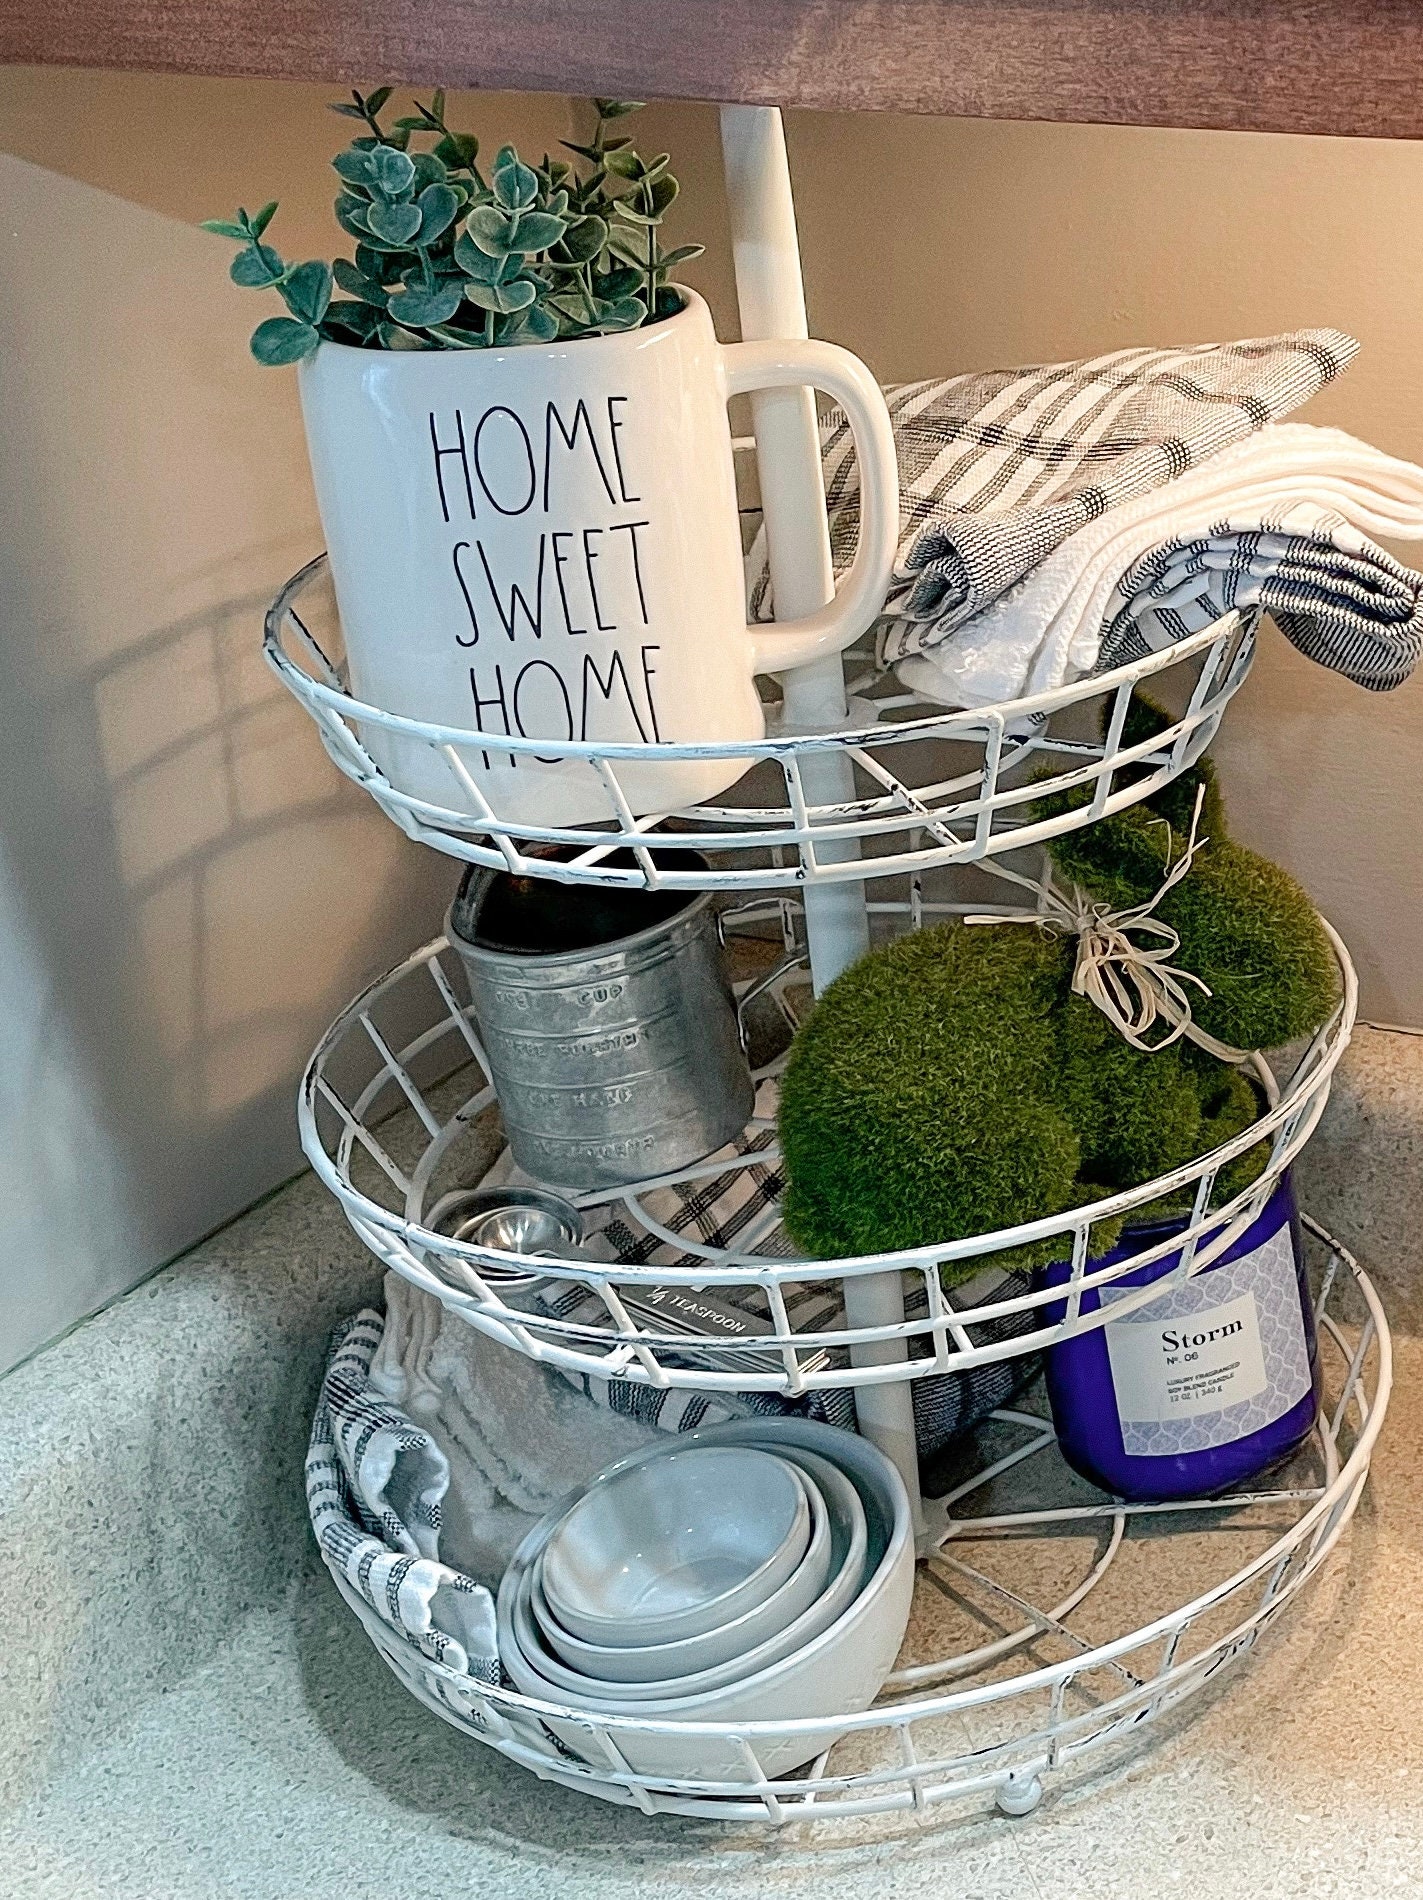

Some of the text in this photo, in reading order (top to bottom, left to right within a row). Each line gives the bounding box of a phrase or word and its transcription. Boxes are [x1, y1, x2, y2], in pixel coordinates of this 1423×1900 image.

[429, 396, 641, 522] HOME
[453, 521, 649, 647] SWEET
[469, 645, 675, 770] HOME
[668, 1294, 747, 1333] TEASPOON
[1161, 1320, 1243, 1352] Storm
[1166, 1375, 1194, 1386] LUXURY
[1183, 1381, 1207, 1392] BLEND
[1208, 1373, 1235, 1385] CANDLE
